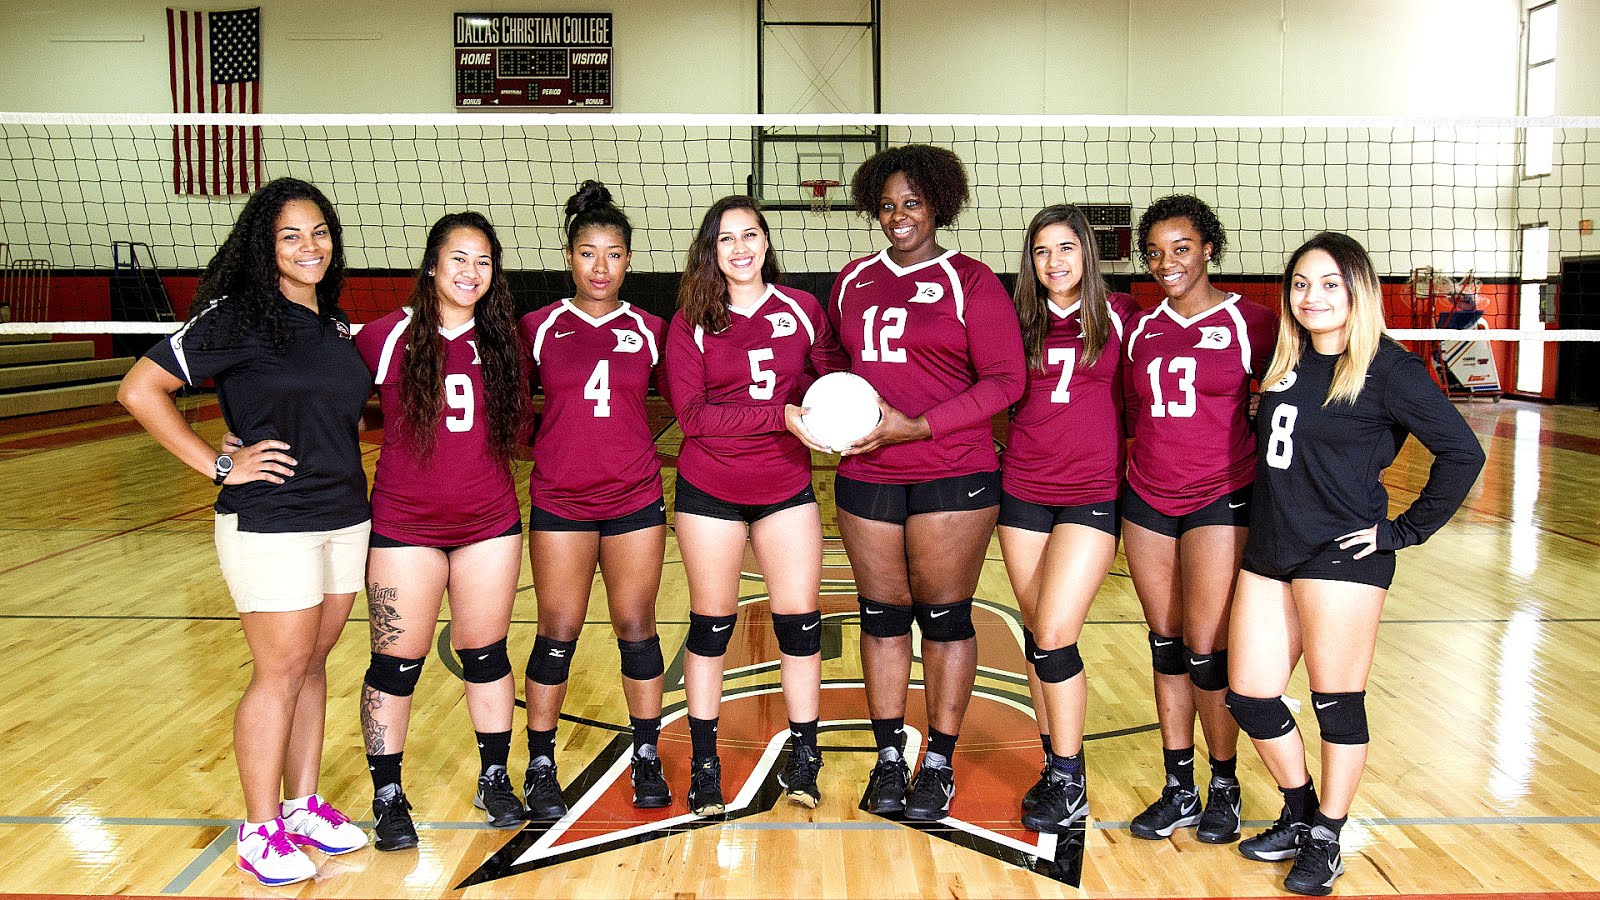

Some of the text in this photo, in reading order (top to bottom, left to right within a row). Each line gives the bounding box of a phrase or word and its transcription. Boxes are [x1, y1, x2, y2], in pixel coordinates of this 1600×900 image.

[456, 16, 610, 44] DALLAS CHRISTIAN COLLEGE
[460, 53, 492, 65] HOME
[572, 53, 608, 65] VISITOR
[861, 306, 908, 363] 12
[443, 373, 475, 432] 9
[583, 359, 611, 418] 4
[748, 347, 777, 401] 5
[1048, 347, 1076, 404] 7
[1146, 356, 1197, 418] 13
[1266, 402, 1299, 470] 8
